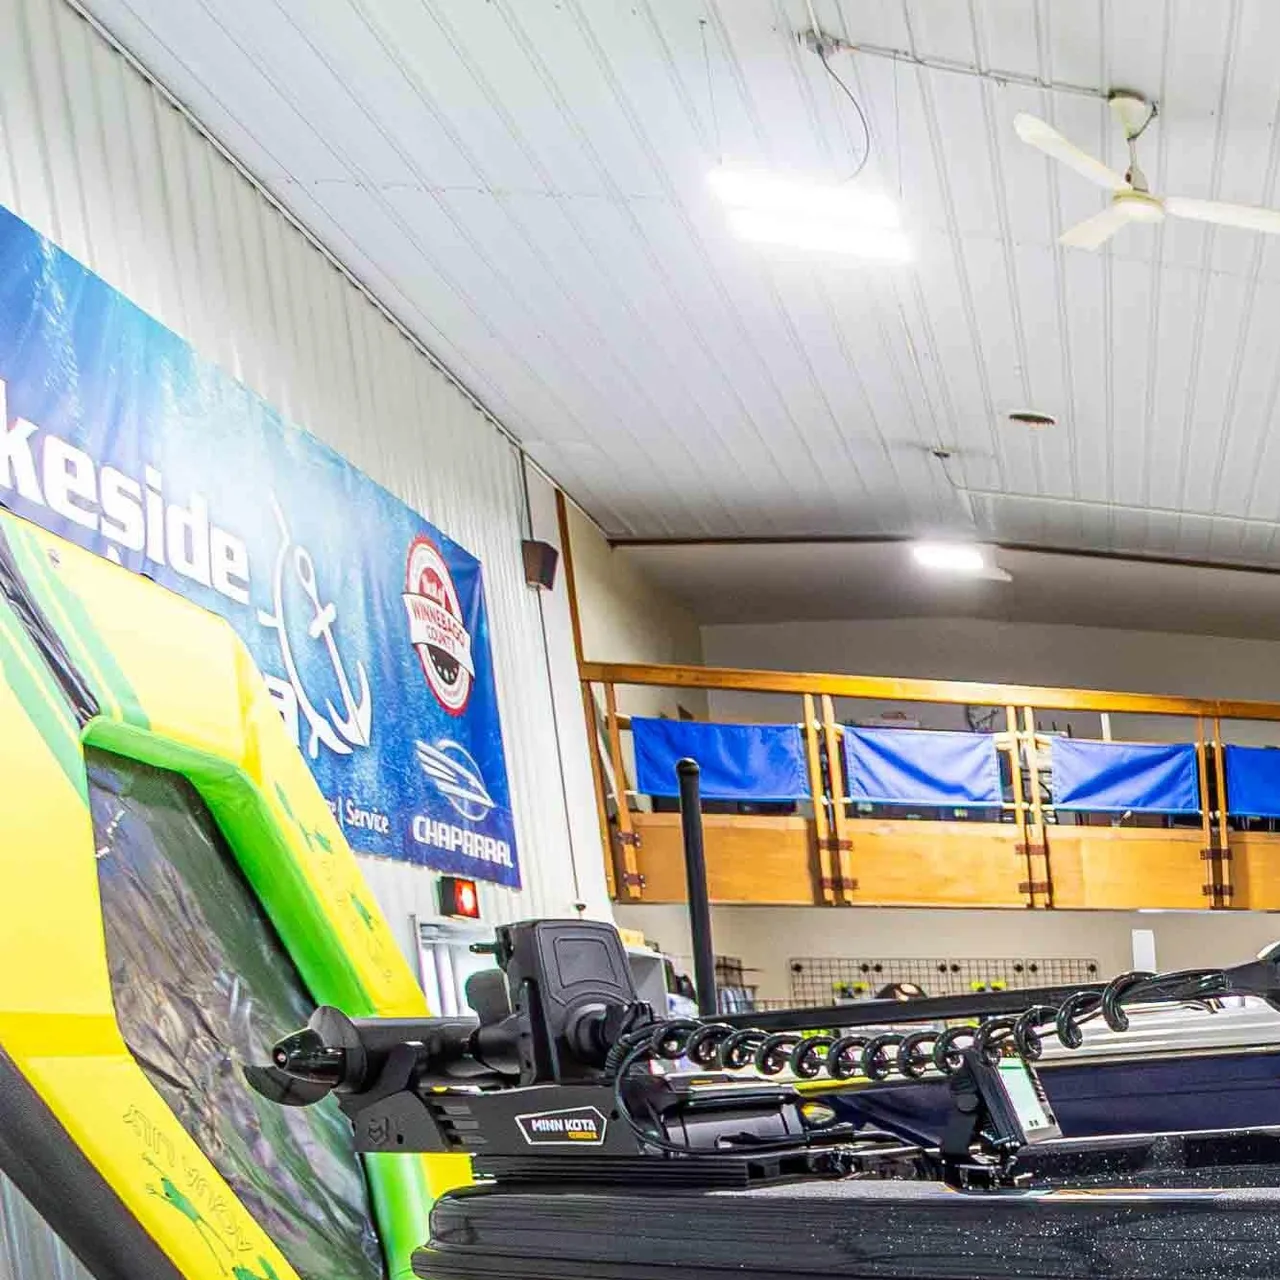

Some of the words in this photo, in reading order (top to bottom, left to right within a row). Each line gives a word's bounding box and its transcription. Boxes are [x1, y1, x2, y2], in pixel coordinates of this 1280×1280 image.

[347, 799, 391, 834] Service
[413, 815, 514, 869] CHAPARRAL
[531, 1119, 563, 1132] MINN
[564, 1119, 597, 1132] KOTA
